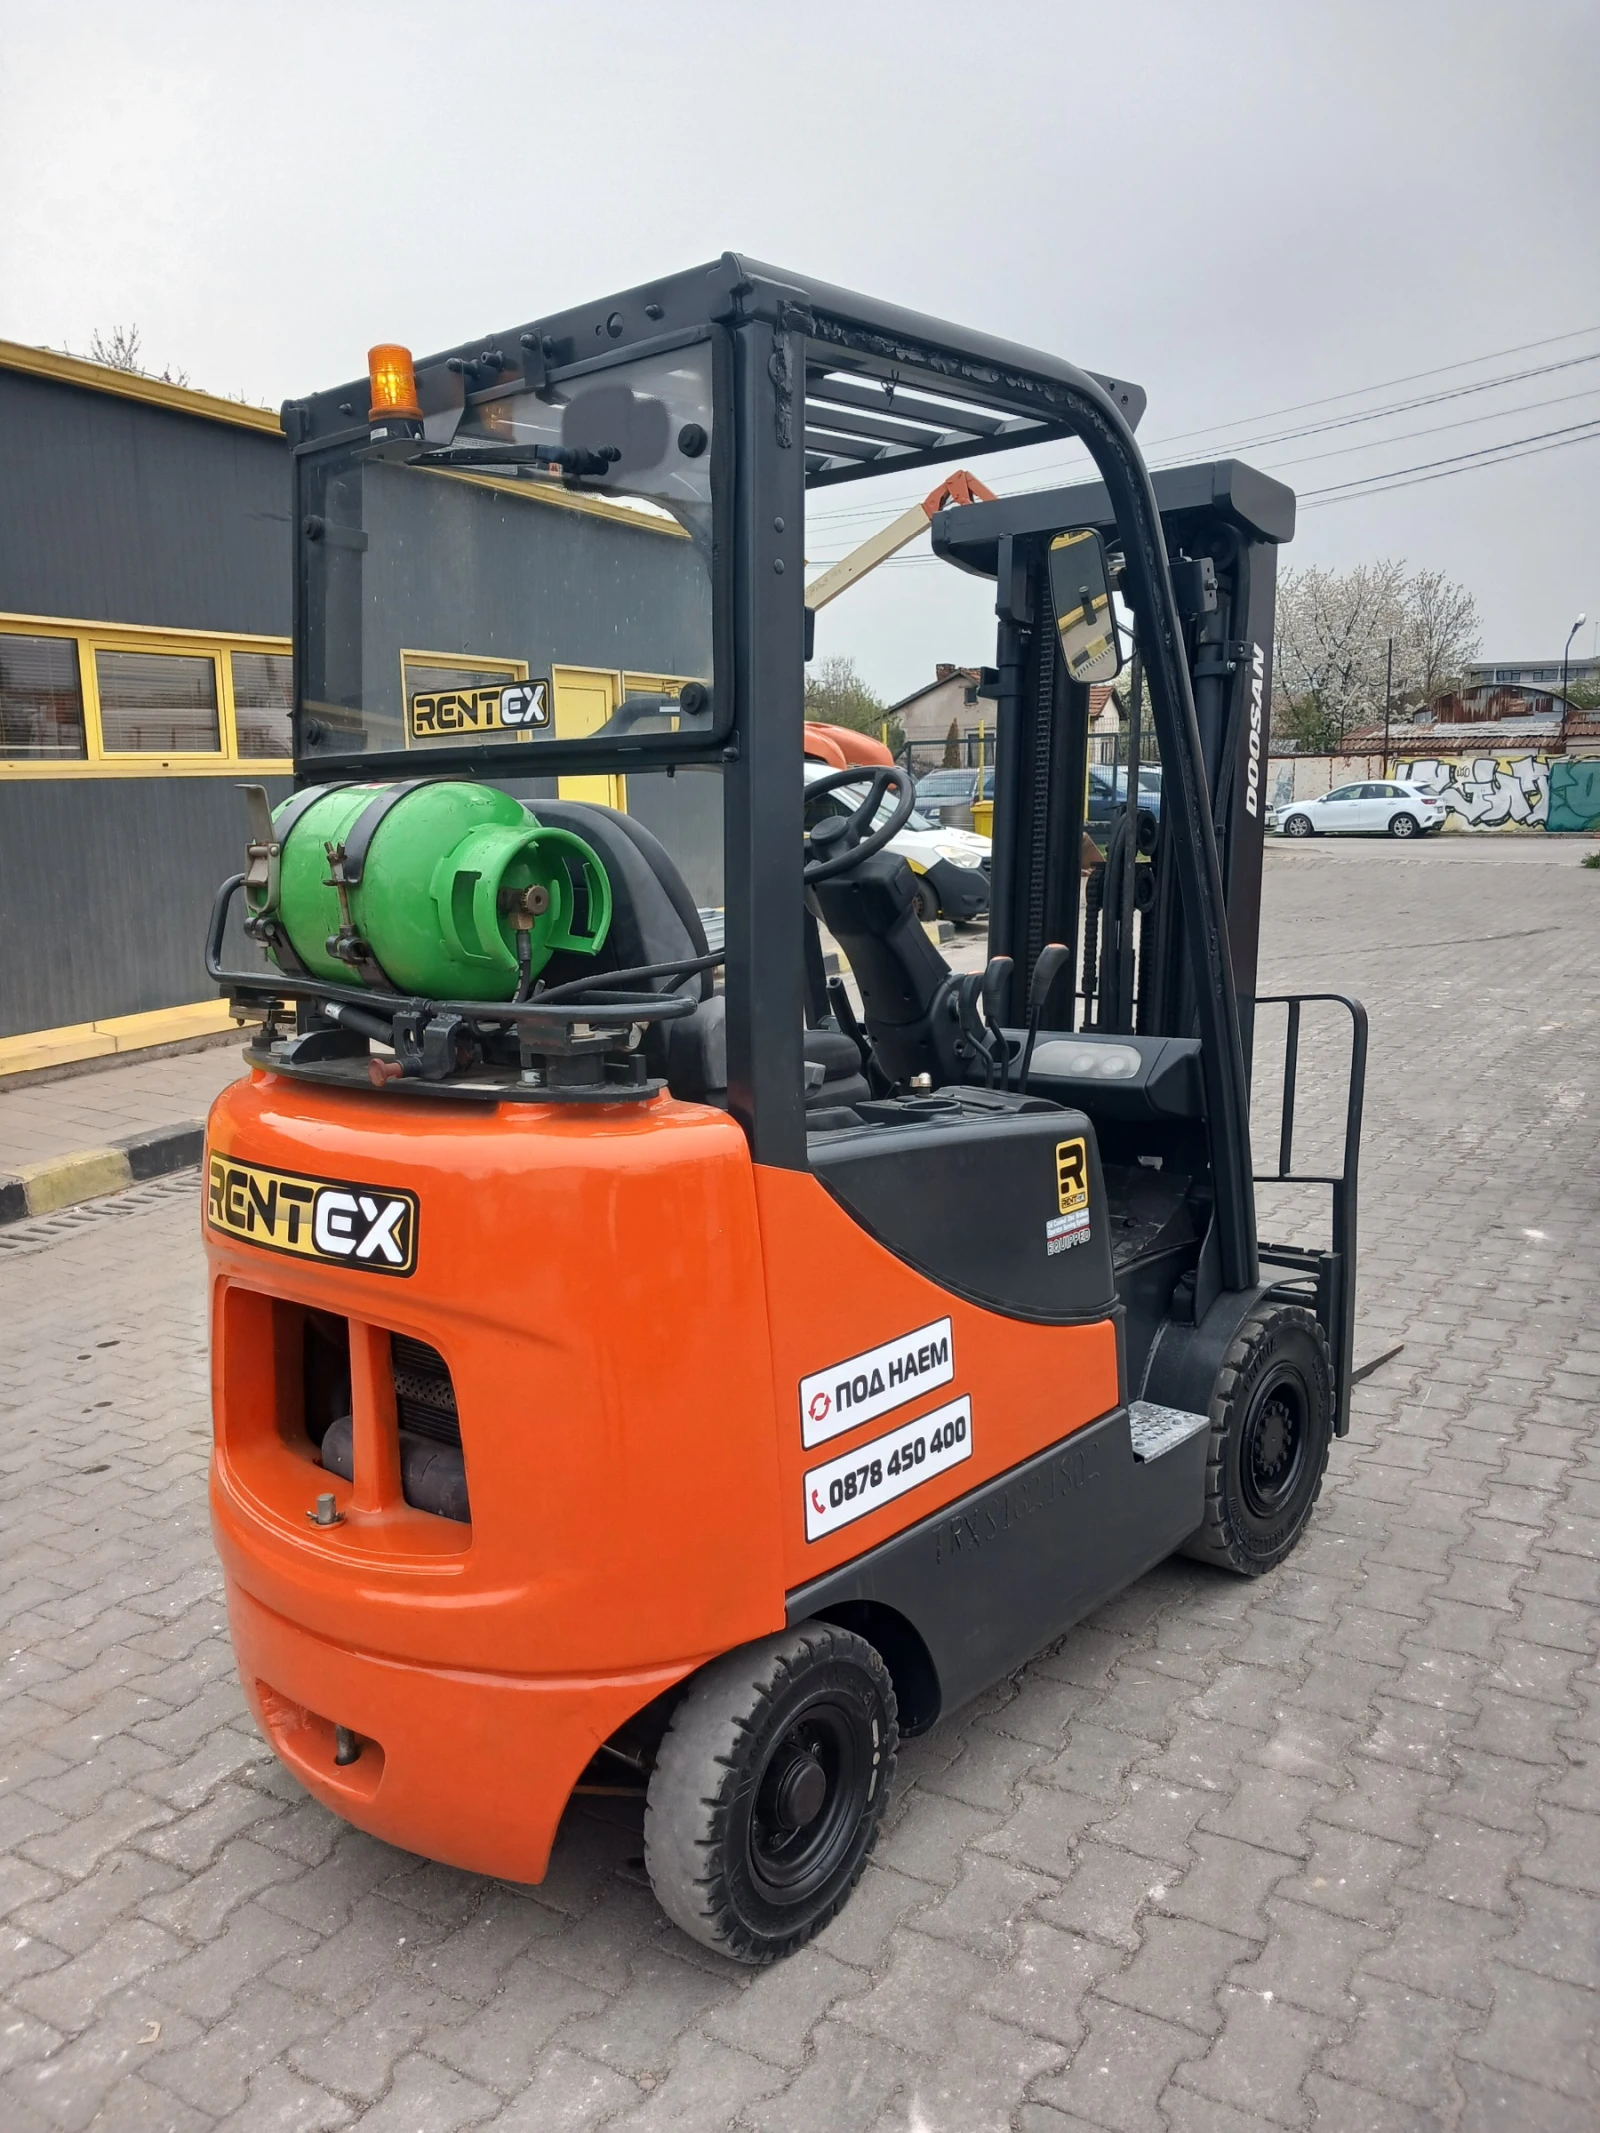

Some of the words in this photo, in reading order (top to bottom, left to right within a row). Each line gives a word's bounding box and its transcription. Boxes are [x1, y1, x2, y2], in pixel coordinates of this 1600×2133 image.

[416, 685, 545, 731] RENTEX
[1246, 642, 1264, 818] DOOSAN
[209, 1161, 406, 1263] RENTEX
[1047, 1228, 1091, 1256] EQUIPPED
[836, 1368, 885, 1413] ПОД
[889, 1337, 949, 1388] НАЕМ
[829, 1459, 883, 1508] 0878
[887, 1436, 926, 1476] 450
[930, 1415, 966, 1454] 400
